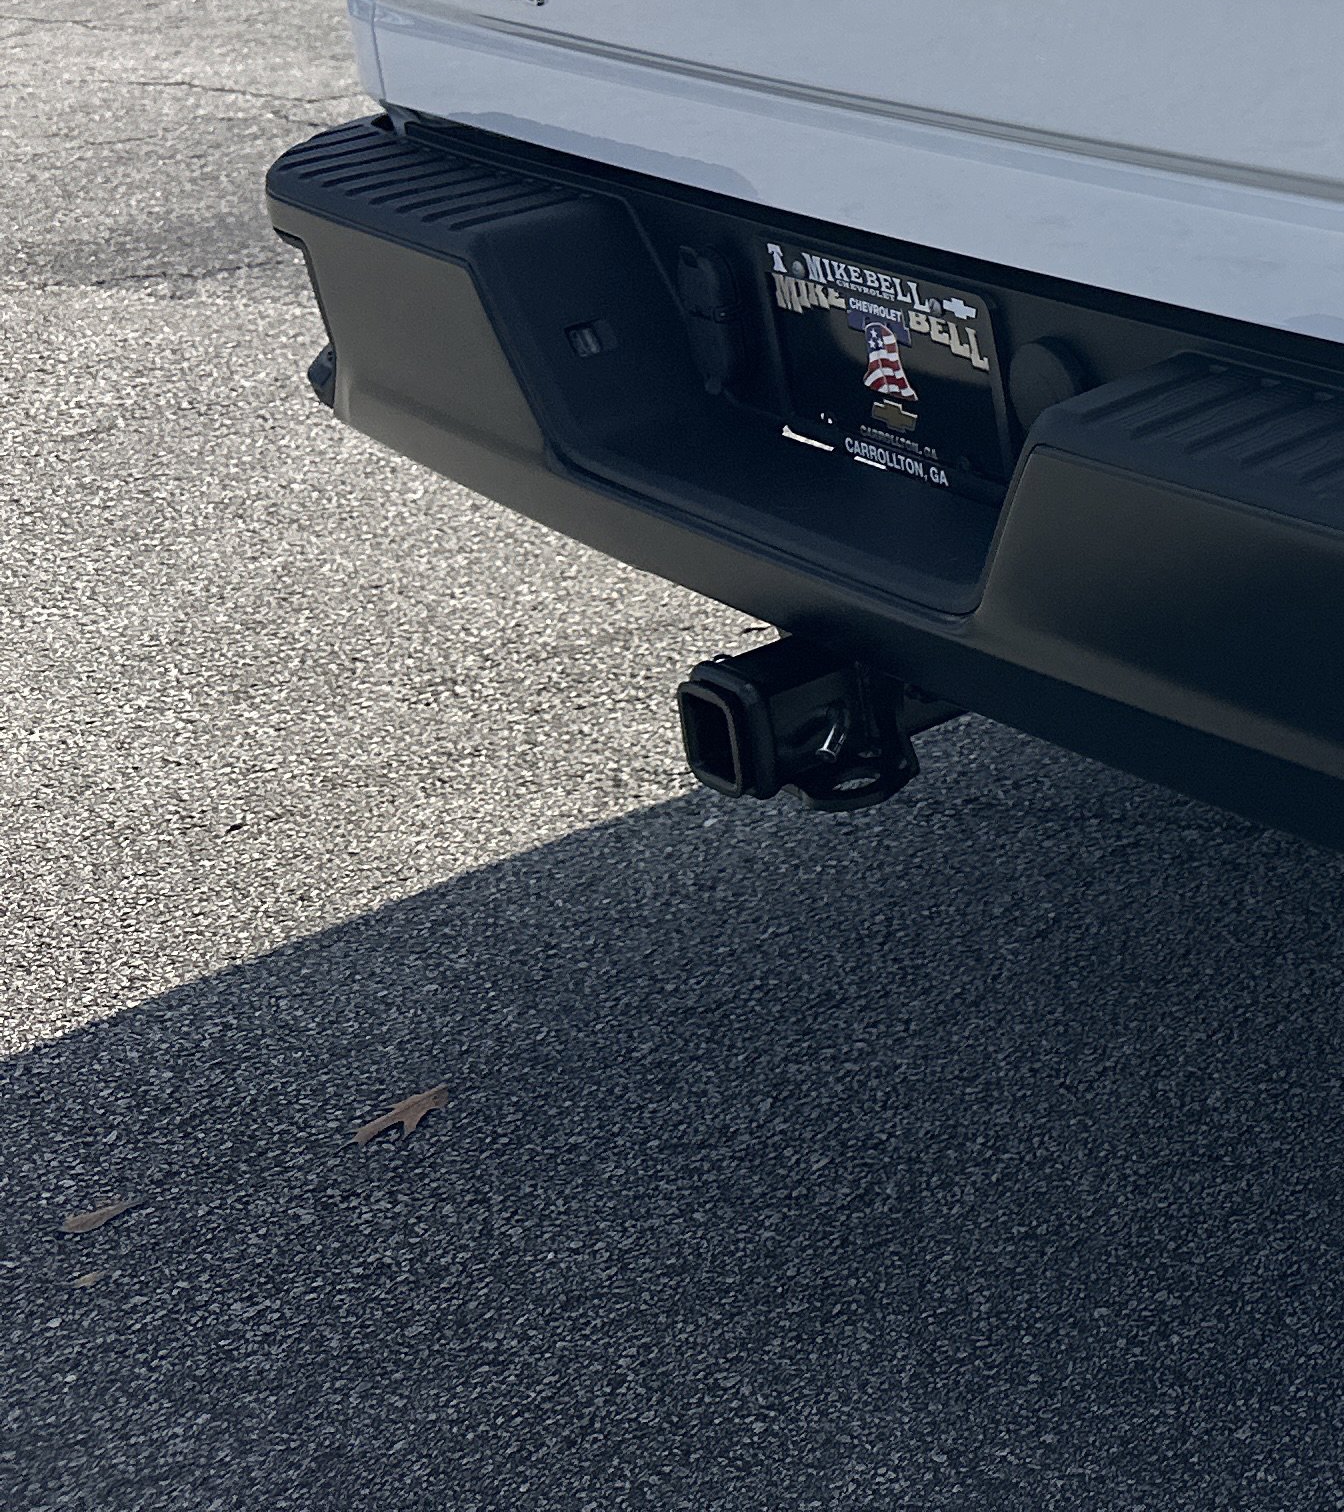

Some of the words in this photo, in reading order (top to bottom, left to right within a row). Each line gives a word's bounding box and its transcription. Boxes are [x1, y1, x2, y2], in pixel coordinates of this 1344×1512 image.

[801, 252, 863, 285] MIKE
[862, 268, 931, 314] BELL
[848, 296, 903, 324] CHEVROLET
[771, 272, 847, 315] MIKE
[907, 309, 991, 373] BELL
[844, 436, 928, 482] CARROLLTON,
[929, 466, 949, 487] GA
